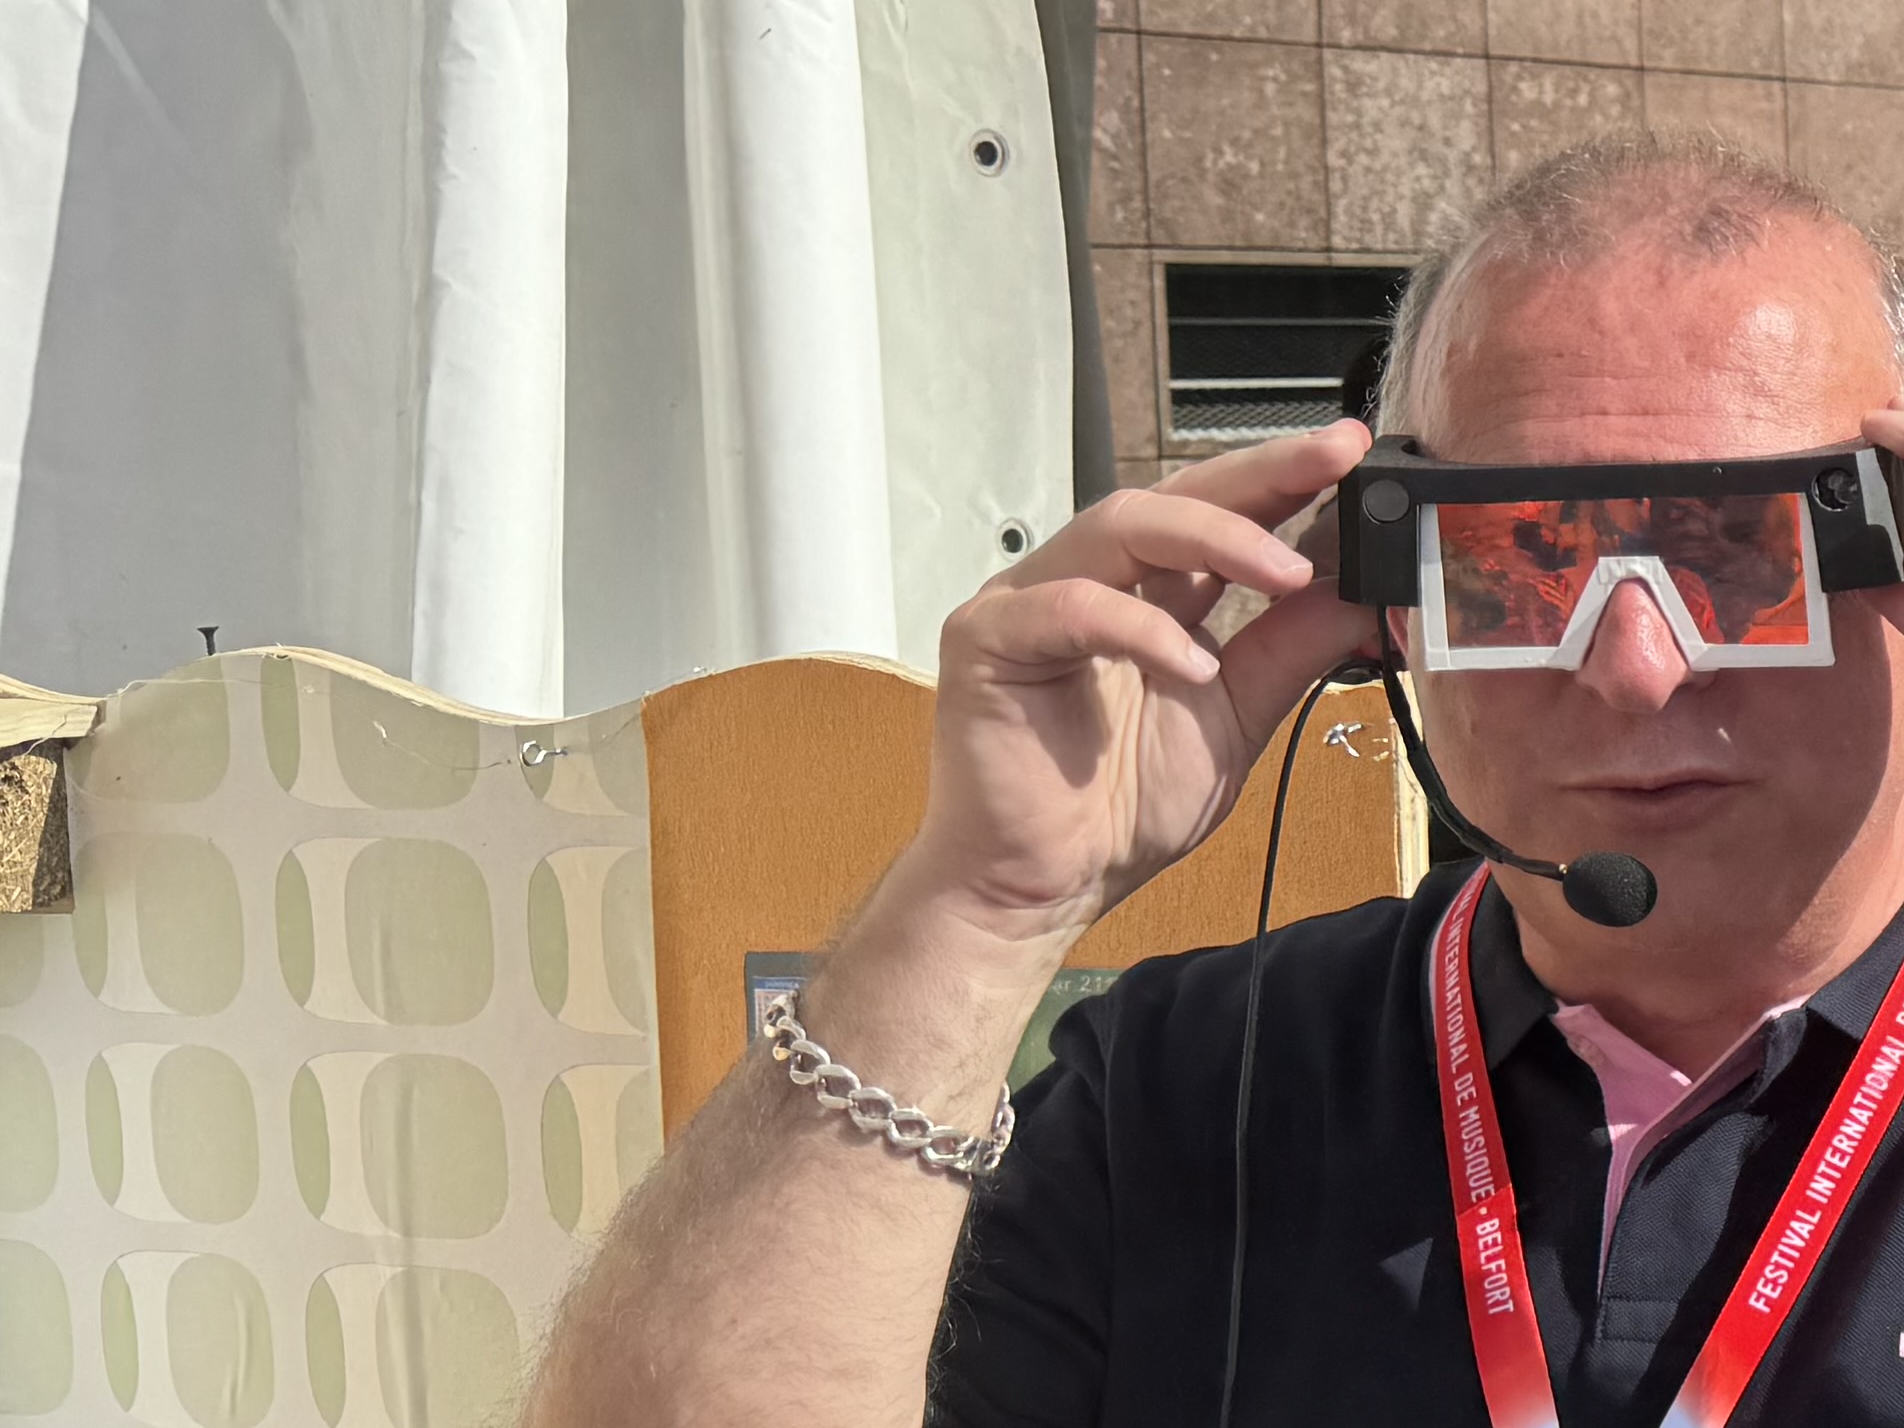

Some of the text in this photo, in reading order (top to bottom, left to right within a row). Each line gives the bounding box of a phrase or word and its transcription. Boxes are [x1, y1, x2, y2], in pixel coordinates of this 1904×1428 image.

[1454, 1072, 1477, 1107] DE
[1459, 1105, 1495, 1202] MUSIQUE
[1476, 1217, 1515, 1315] BELFORT
[1749, 1206, 1822, 1315] FESTIVAL
